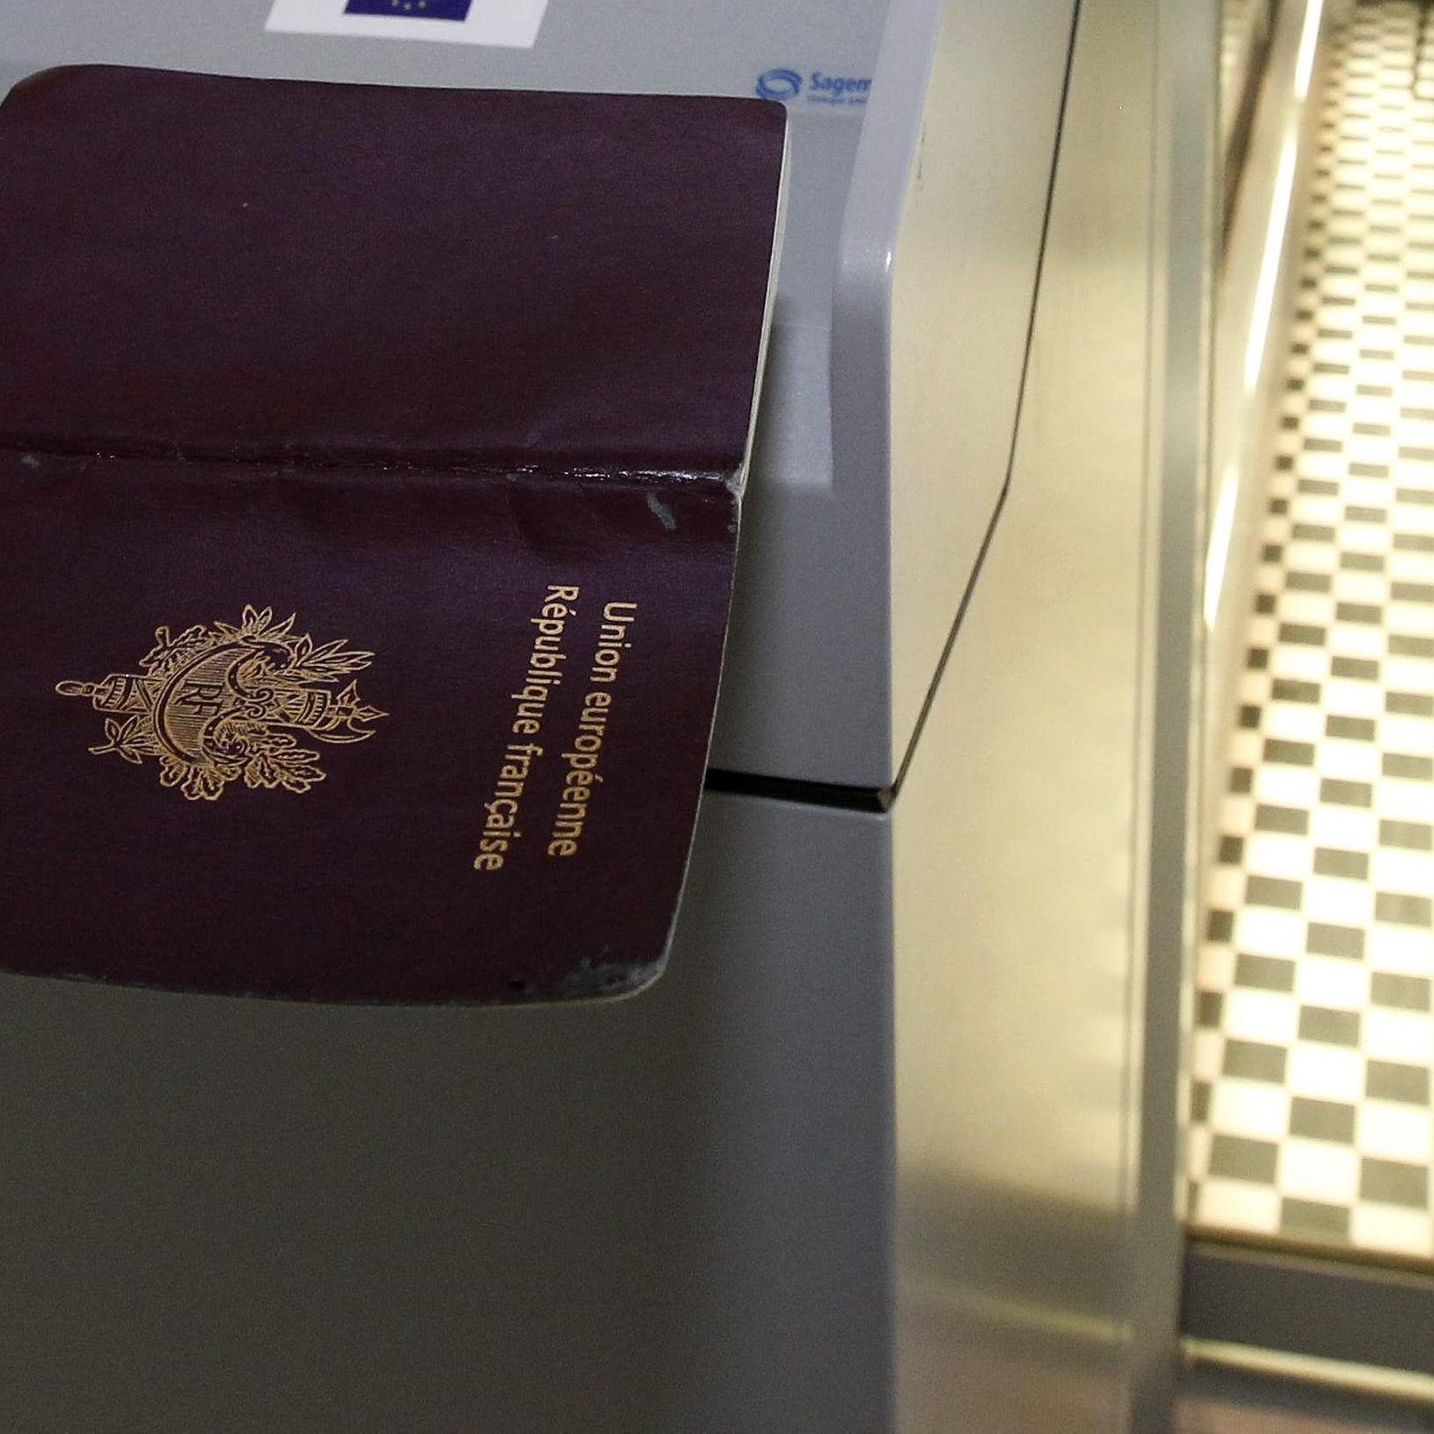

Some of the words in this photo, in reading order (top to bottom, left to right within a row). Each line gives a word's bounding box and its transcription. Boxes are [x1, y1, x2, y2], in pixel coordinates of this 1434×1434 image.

[511, 584, 580, 734] République
[589, 601, 637, 683] Union
[473, 742, 543, 871] française
[547, 691, 612, 856] européenne
